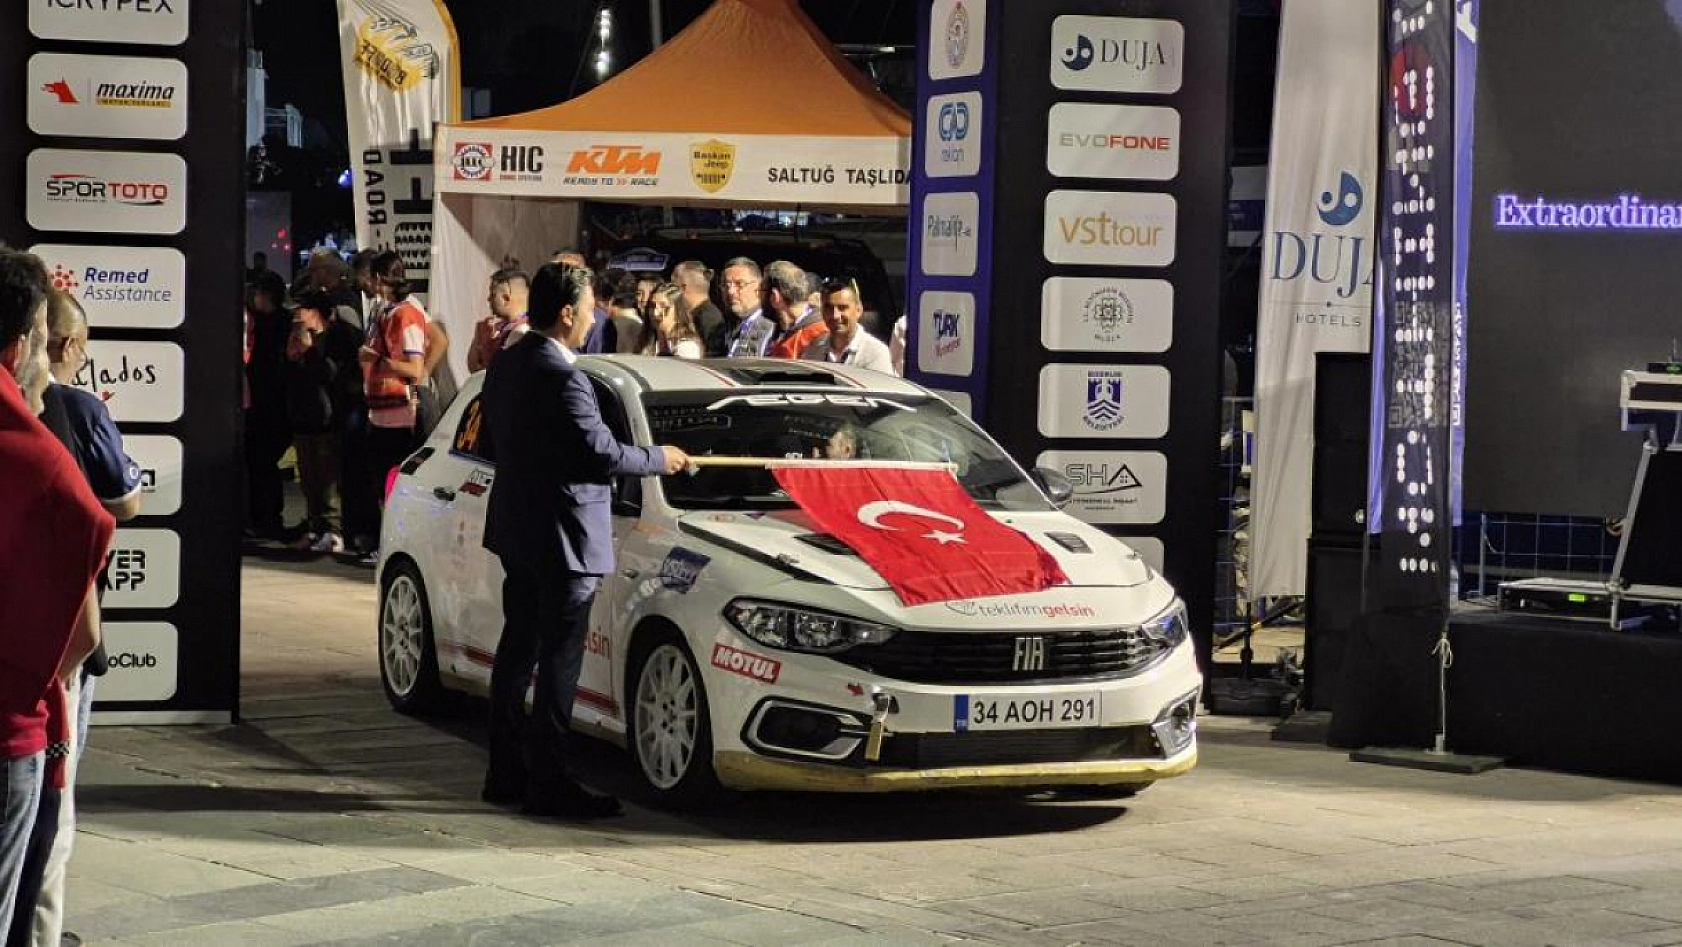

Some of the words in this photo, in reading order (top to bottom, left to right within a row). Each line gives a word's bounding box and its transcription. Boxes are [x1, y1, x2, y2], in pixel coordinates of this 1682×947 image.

[1101, 38, 1166, 71] DUJA
[96, 80, 175, 100] maxima
[1059, 133, 1171, 150] EVOFONE
[500, 145, 544, 172] HIC
[565, 144, 662, 175] KTM
[767, 164, 835, 184] SALTUĞ
[1496, 193, 1682, 228] Extraordina
[84, 267, 149, 284] Remed
[1270, 231, 1374, 299] DUJ
[83, 285, 172, 302] Assistance
[1296, 312, 1361, 327] HOTELS
[108, 652, 157, 668] oClub
[714, 647, 776, 680] MOTUL
[973, 701, 998, 724] 34
[1003, 699, 1054, 723] AOH
[1060, 698, 1095, 721] 291
